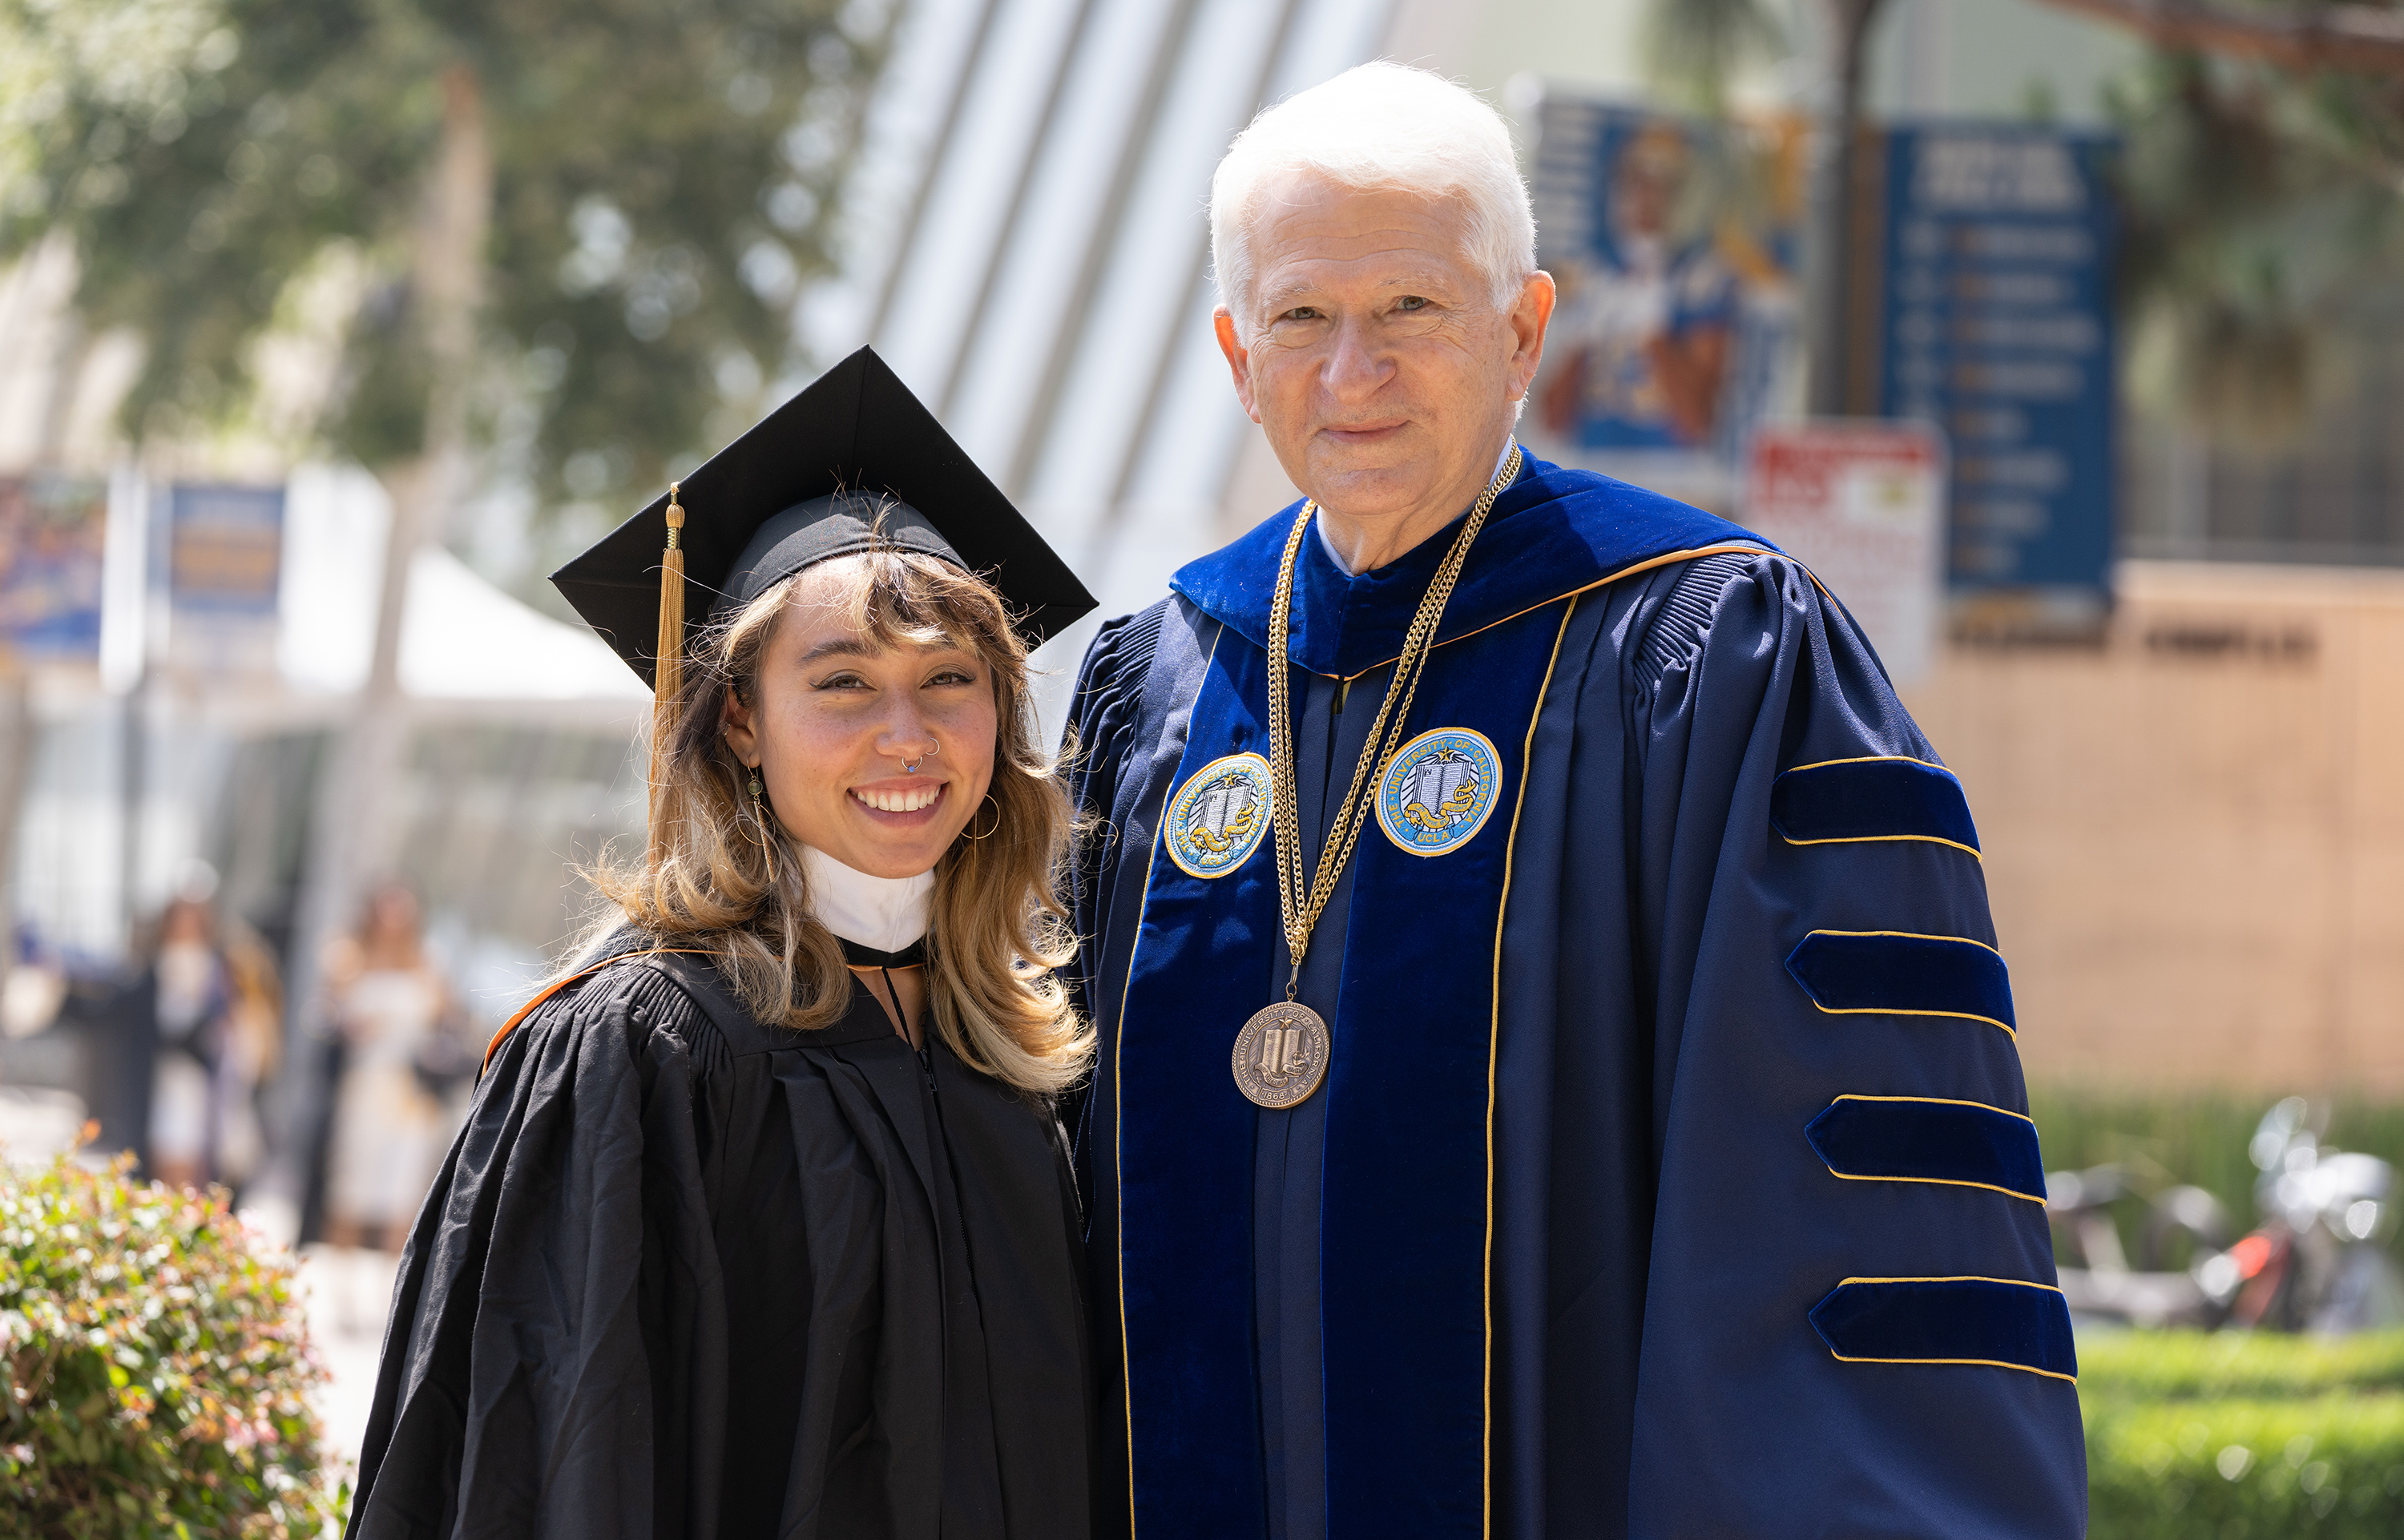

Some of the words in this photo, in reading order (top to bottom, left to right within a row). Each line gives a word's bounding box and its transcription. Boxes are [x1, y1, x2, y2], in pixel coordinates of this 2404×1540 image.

[1454, 740, 1471, 750] OF
[1239, 764, 1252, 774] OF
[1388, 740, 1447, 793] UNIVERSITY
[1177, 766, 1234, 821] UNIVERSITY
[1467, 750, 1490, 824] CALIFORNIA
[1244, 772, 1265, 844] CALIFORNIA
[1388, 803, 1404, 828] THE
[1177, 829, 1191, 853] THE
[1418, 832, 1450, 843] UCLA
[1201, 854, 1231, 865] UCLA
[1292, 1011, 1305, 1019] OF
[1240, 1010, 1287, 1055] UNIVERSITY
[1301, 1022, 1322, 1085] CALIFORNIA
[1239, 1063, 1252, 1086] THE
[1263, 1091, 1286, 1099] 1868
